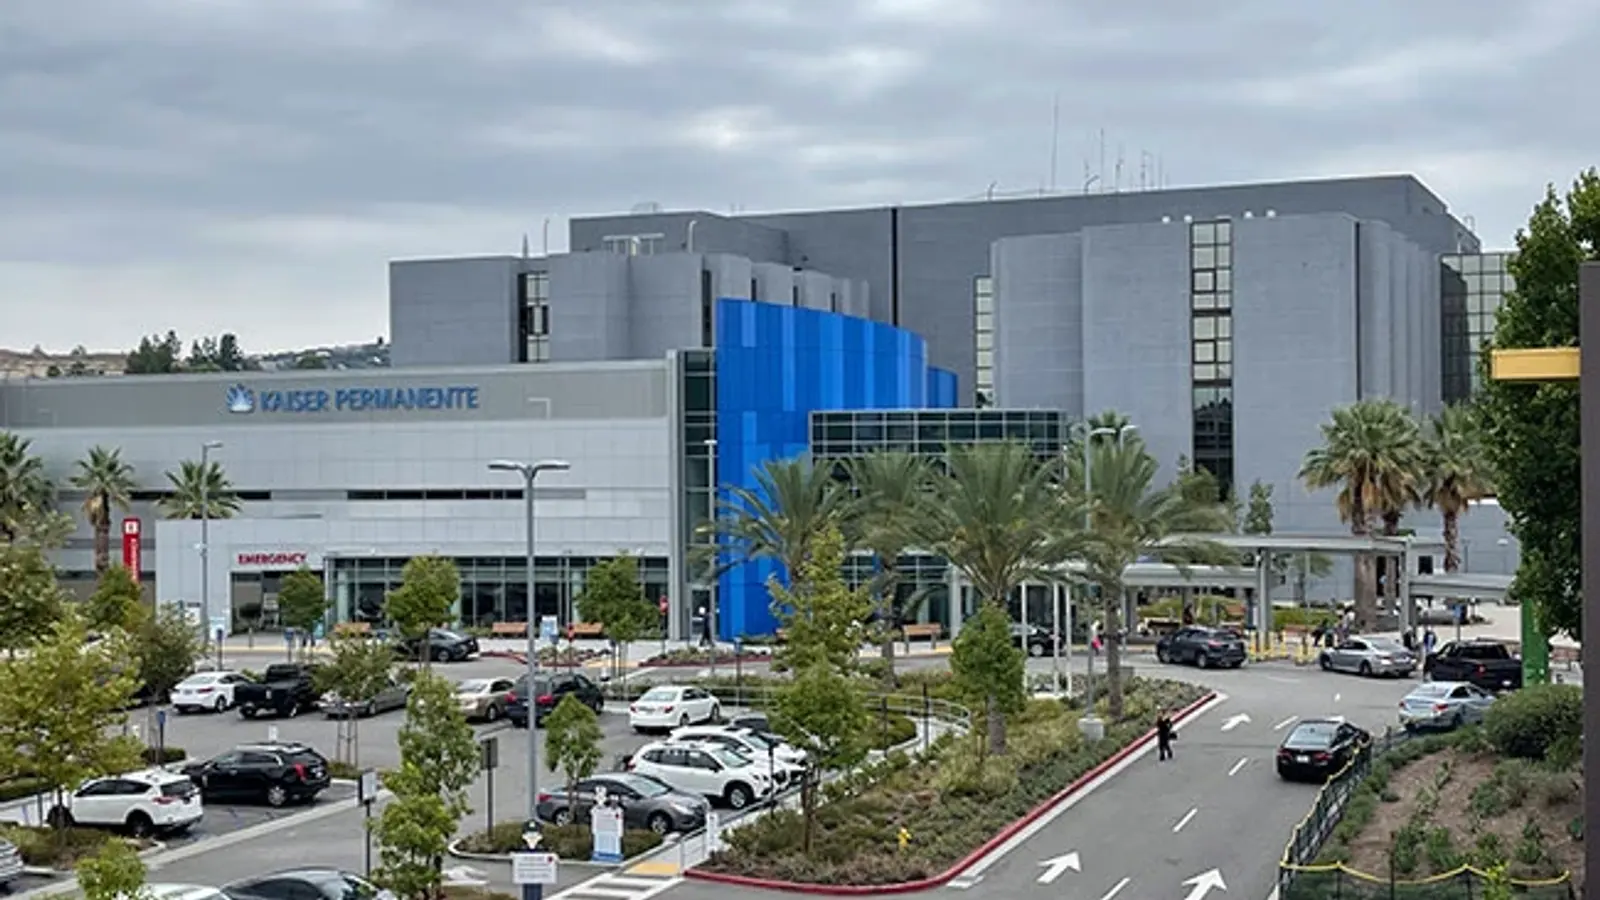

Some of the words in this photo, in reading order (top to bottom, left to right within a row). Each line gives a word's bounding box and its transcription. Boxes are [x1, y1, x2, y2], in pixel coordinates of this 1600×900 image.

[260, 388, 329, 411] KAISER
[335, 386, 479, 410] PERMANENTE
[238, 553, 307, 565] EMERGENCY
